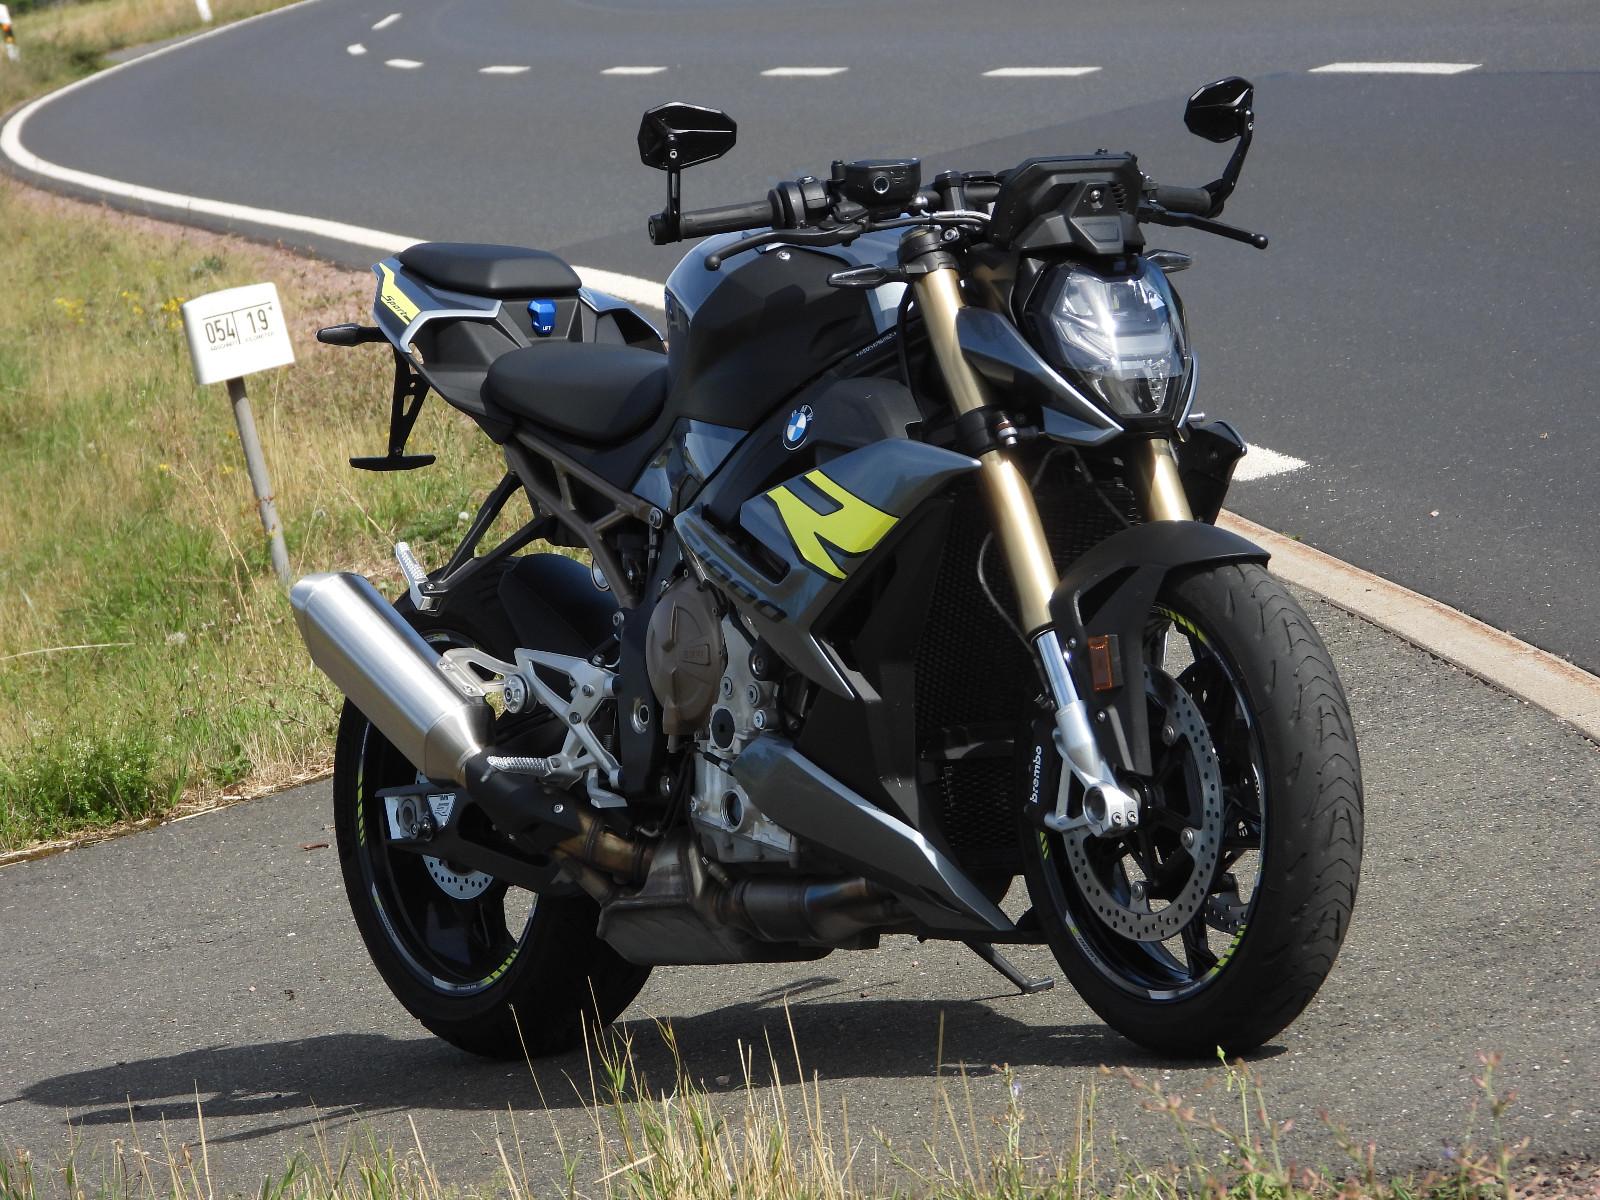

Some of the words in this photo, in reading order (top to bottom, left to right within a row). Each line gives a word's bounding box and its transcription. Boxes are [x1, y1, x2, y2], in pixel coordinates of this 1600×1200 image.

[205, 317, 236, 344] 054
[766, 469, 900, 581] R
[1029, 745, 1042, 803] brembo
